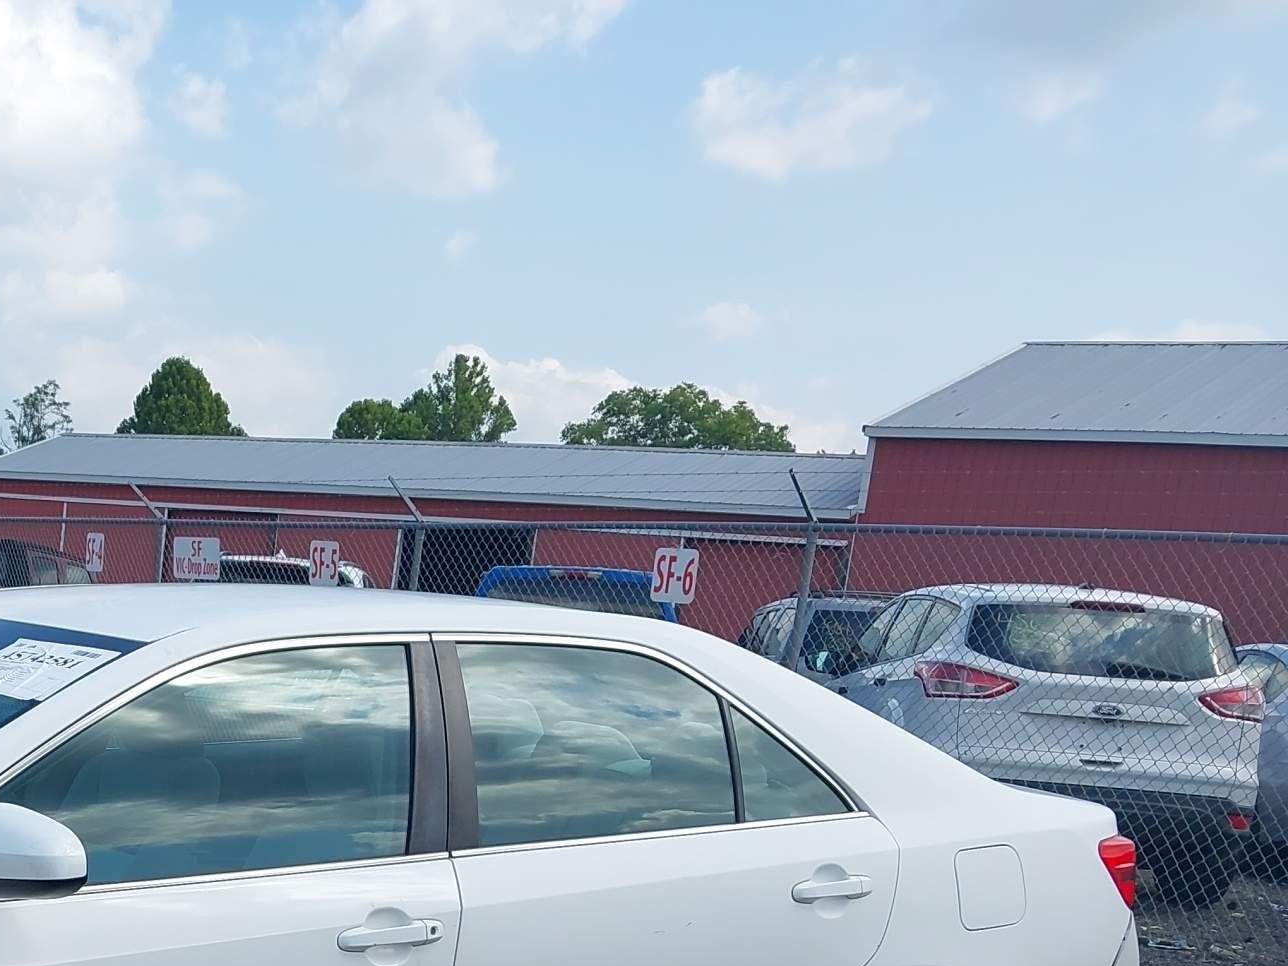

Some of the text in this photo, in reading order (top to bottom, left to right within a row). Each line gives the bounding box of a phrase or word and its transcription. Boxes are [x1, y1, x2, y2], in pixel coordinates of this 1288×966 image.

[192, 540, 202, 557] SF
[203, 558, 218, 576] Zone
[312, 546, 337, 580] SF-5
[653, 554, 695, 595] SF-6
[2, 650, 84, 669] 45742581
